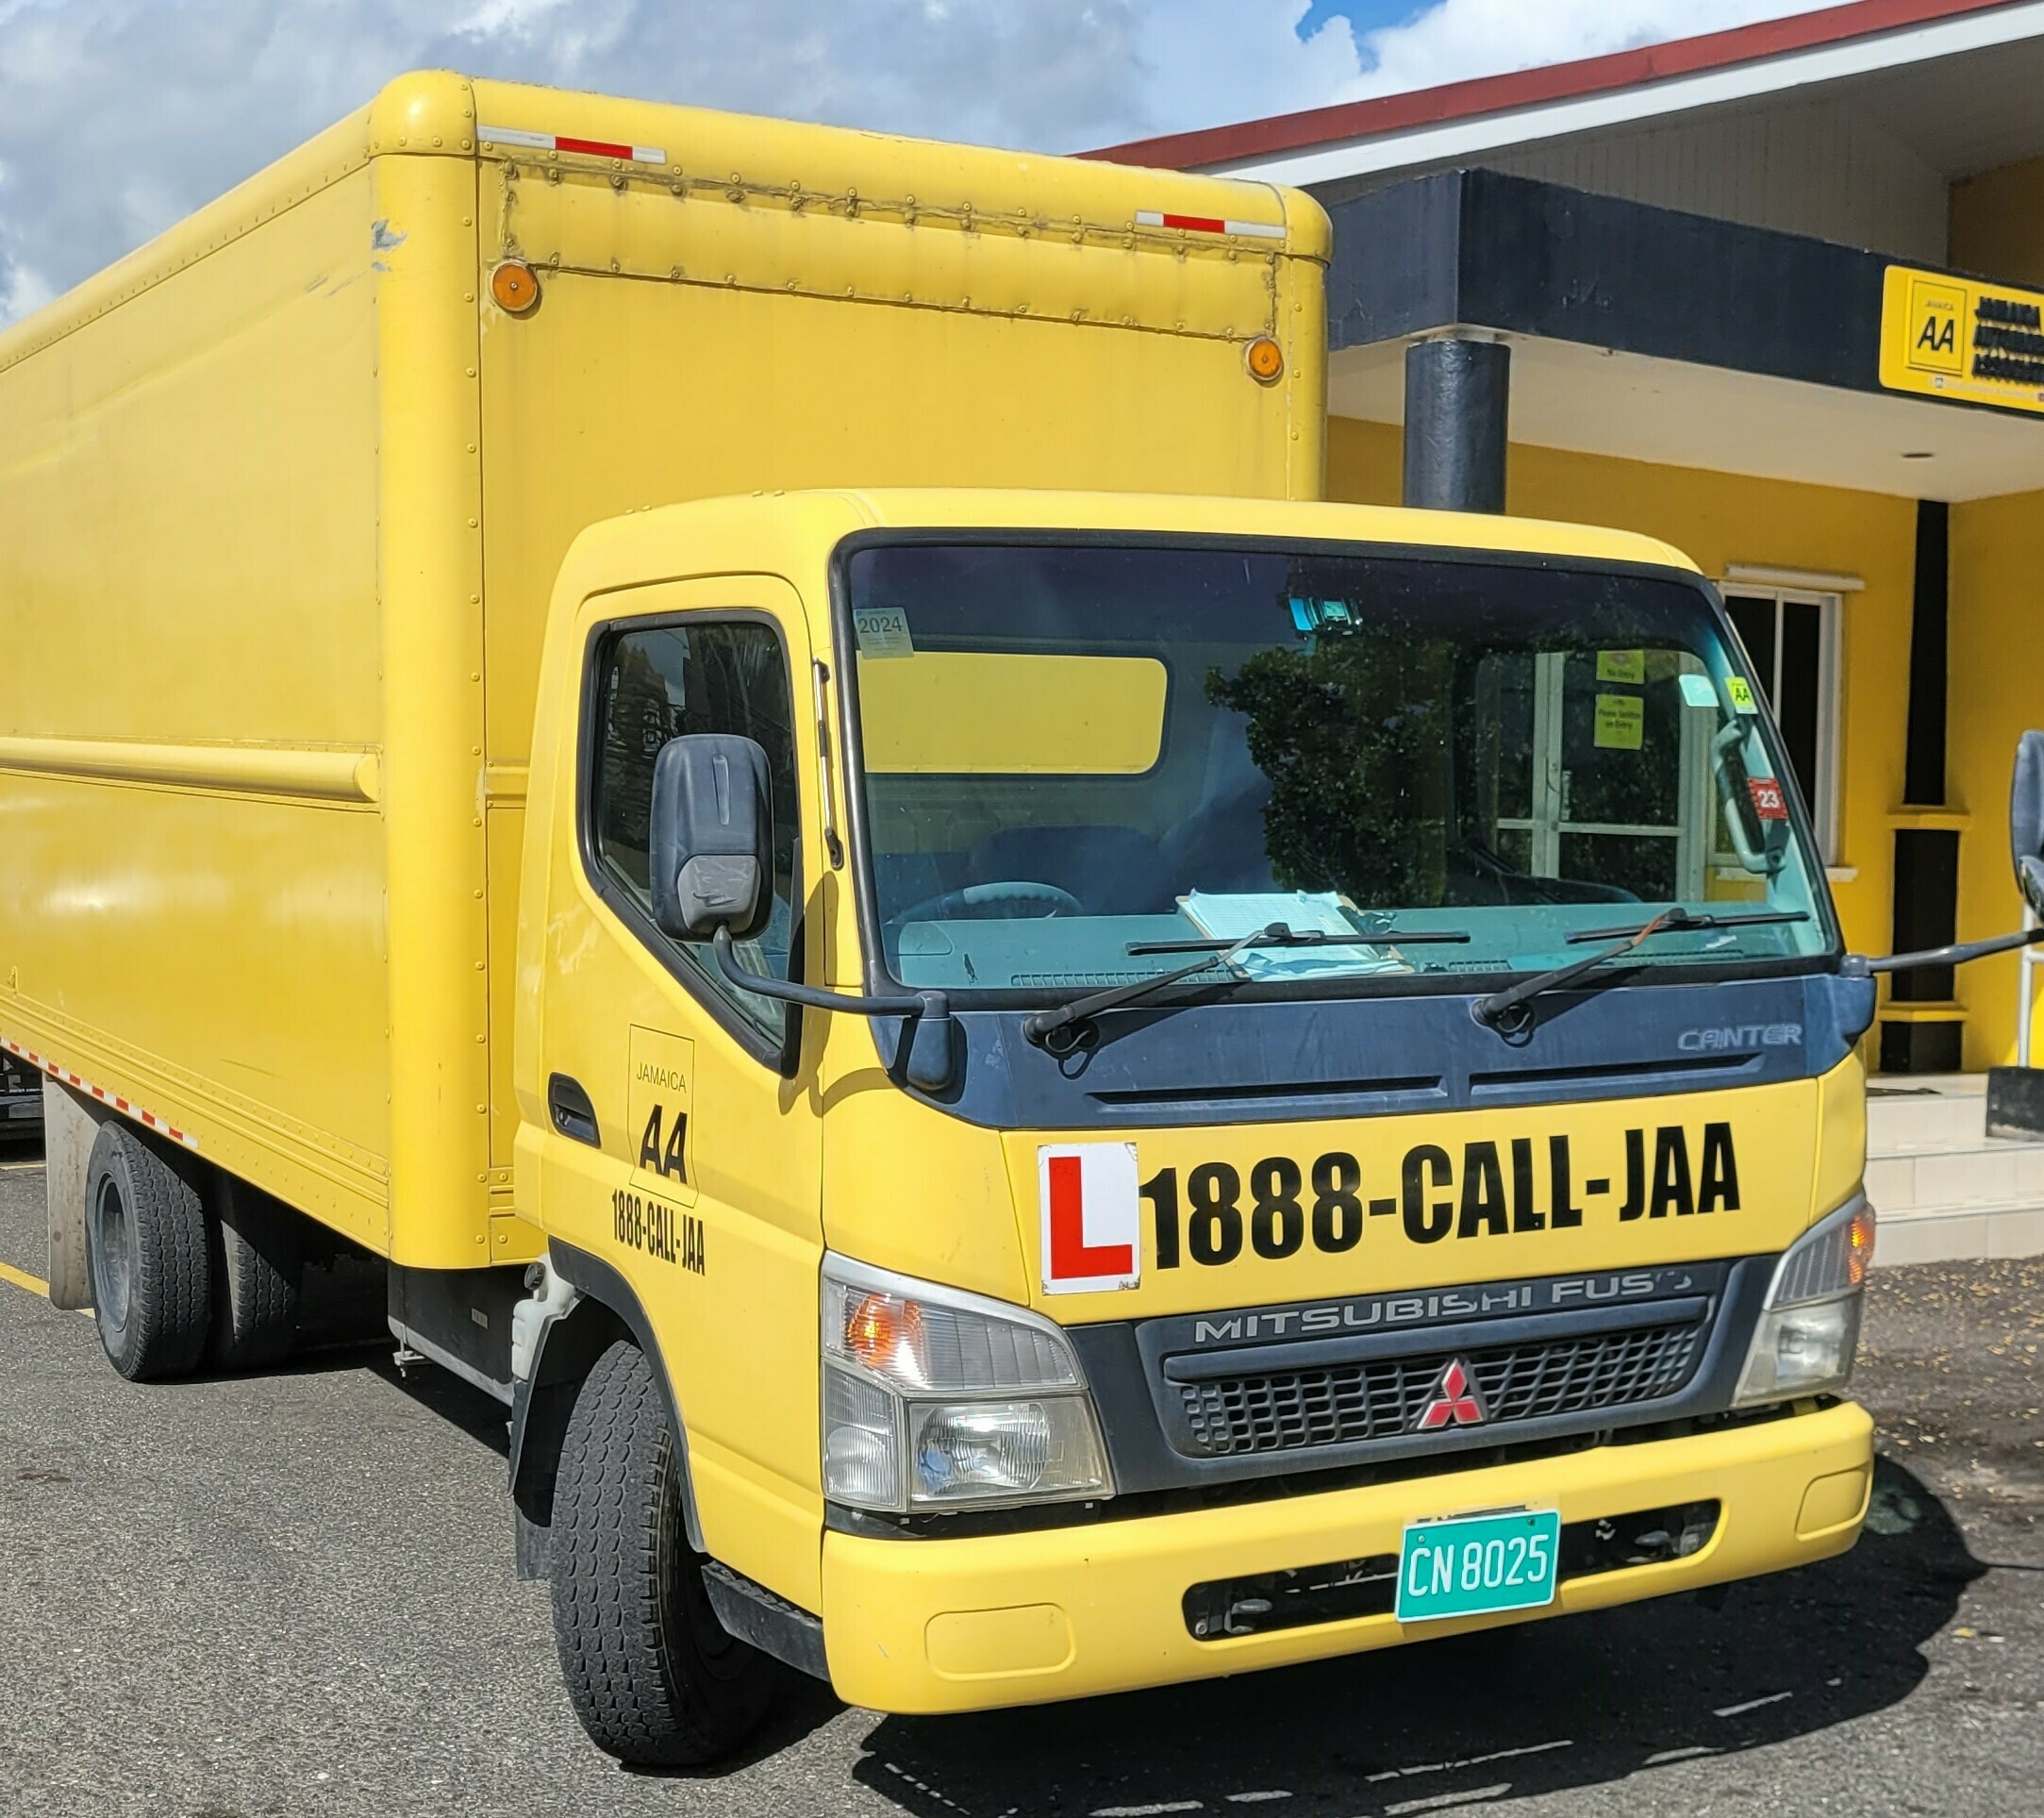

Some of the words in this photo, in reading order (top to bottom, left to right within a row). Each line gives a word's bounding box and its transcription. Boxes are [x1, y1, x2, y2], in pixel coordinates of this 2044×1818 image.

[1917, 316, 1954, 354] AA
[858, 616, 902, 634] 2024
[1757, 790, 1780, 809] 23
[1678, 1023, 1803, 1051] CANTER
[637, 1062, 687, 1093] JAMAICA
[639, 1104, 688, 1185] AA
[1049, 1157, 1133, 1279] L
[1139, 1122, 1741, 1270] 1888-CALL-JAA
[612, 1189, 706, 1276] 1888-CALL-JAA
[1194, 1287, 1532, 1343] MITSUBISHI
[1408, 1544, 1454, 1596] CN
[1461, 1534, 1549, 1591] 8025
